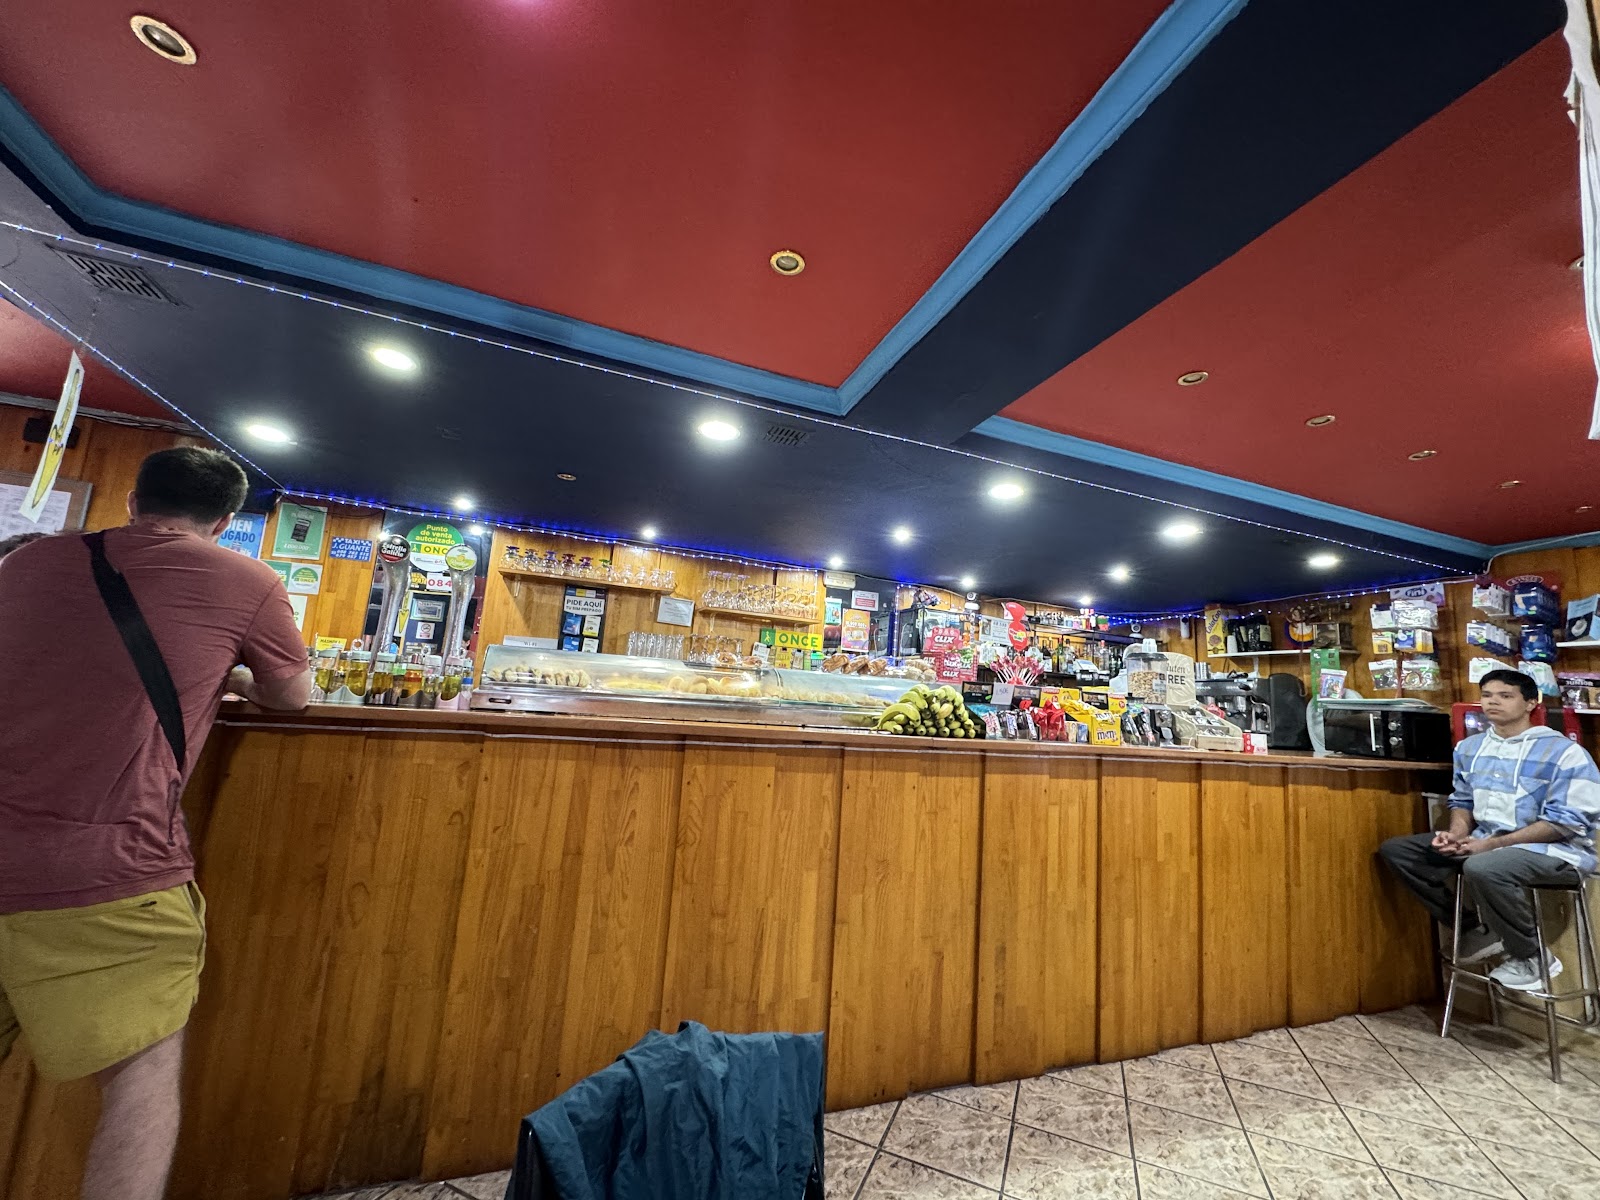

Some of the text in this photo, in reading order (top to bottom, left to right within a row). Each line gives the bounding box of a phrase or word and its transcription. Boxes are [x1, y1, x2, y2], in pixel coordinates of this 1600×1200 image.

[231, 519, 253, 532] IEN
[426, 524, 449, 533] Punto
[220, 530, 256, 543] UGADO
[415, 535, 456, 545] autorizado
[431, 531, 453, 539] venta
[382, 541, 407, 553] Estrella
[423, 545, 448, 555] ONC
[381, 547, 404, 558] Galicia
[584, 600, 602, 608] AQUÍ
[1206, 609, 1221, 634] ColaCao
[778, 632, 818, 648] ONCE
[934, 635, 954, 643] CLIX
[1167, 663, 1186, 673] luten
[942, 670, 960, 678] CLIX
[1167, 674, 1186, 685] REE
